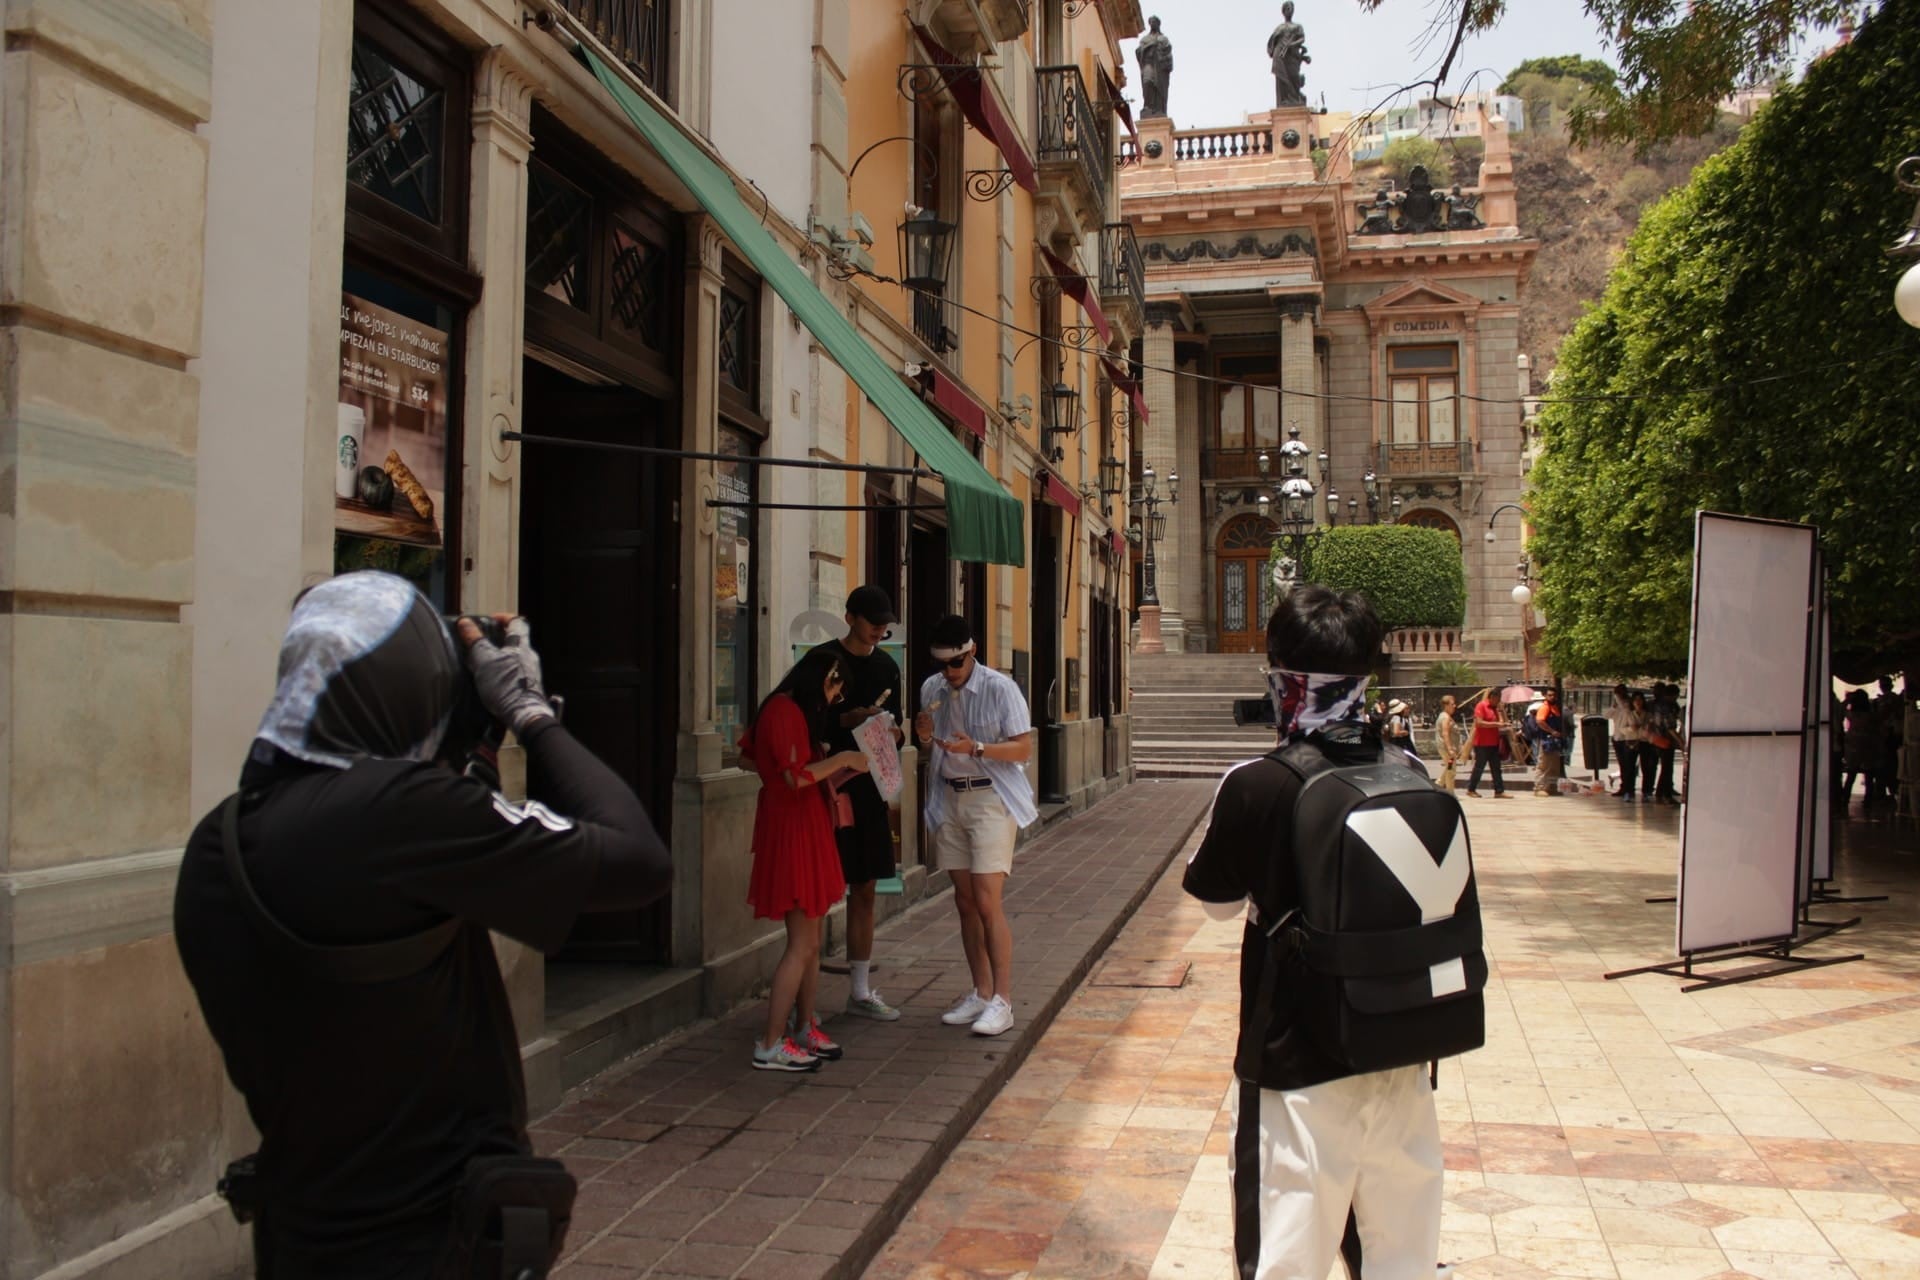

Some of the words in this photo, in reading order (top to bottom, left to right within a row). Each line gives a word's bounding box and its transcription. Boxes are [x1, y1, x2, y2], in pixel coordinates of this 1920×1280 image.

[354, 311, 397, 338] mejores
[400, 328, 440, 355] mañanas
[1393, 320, 1450, 331] COMEDIA
[377, 342, 389, 357] EN
[412, 386, 429, 403] $34
